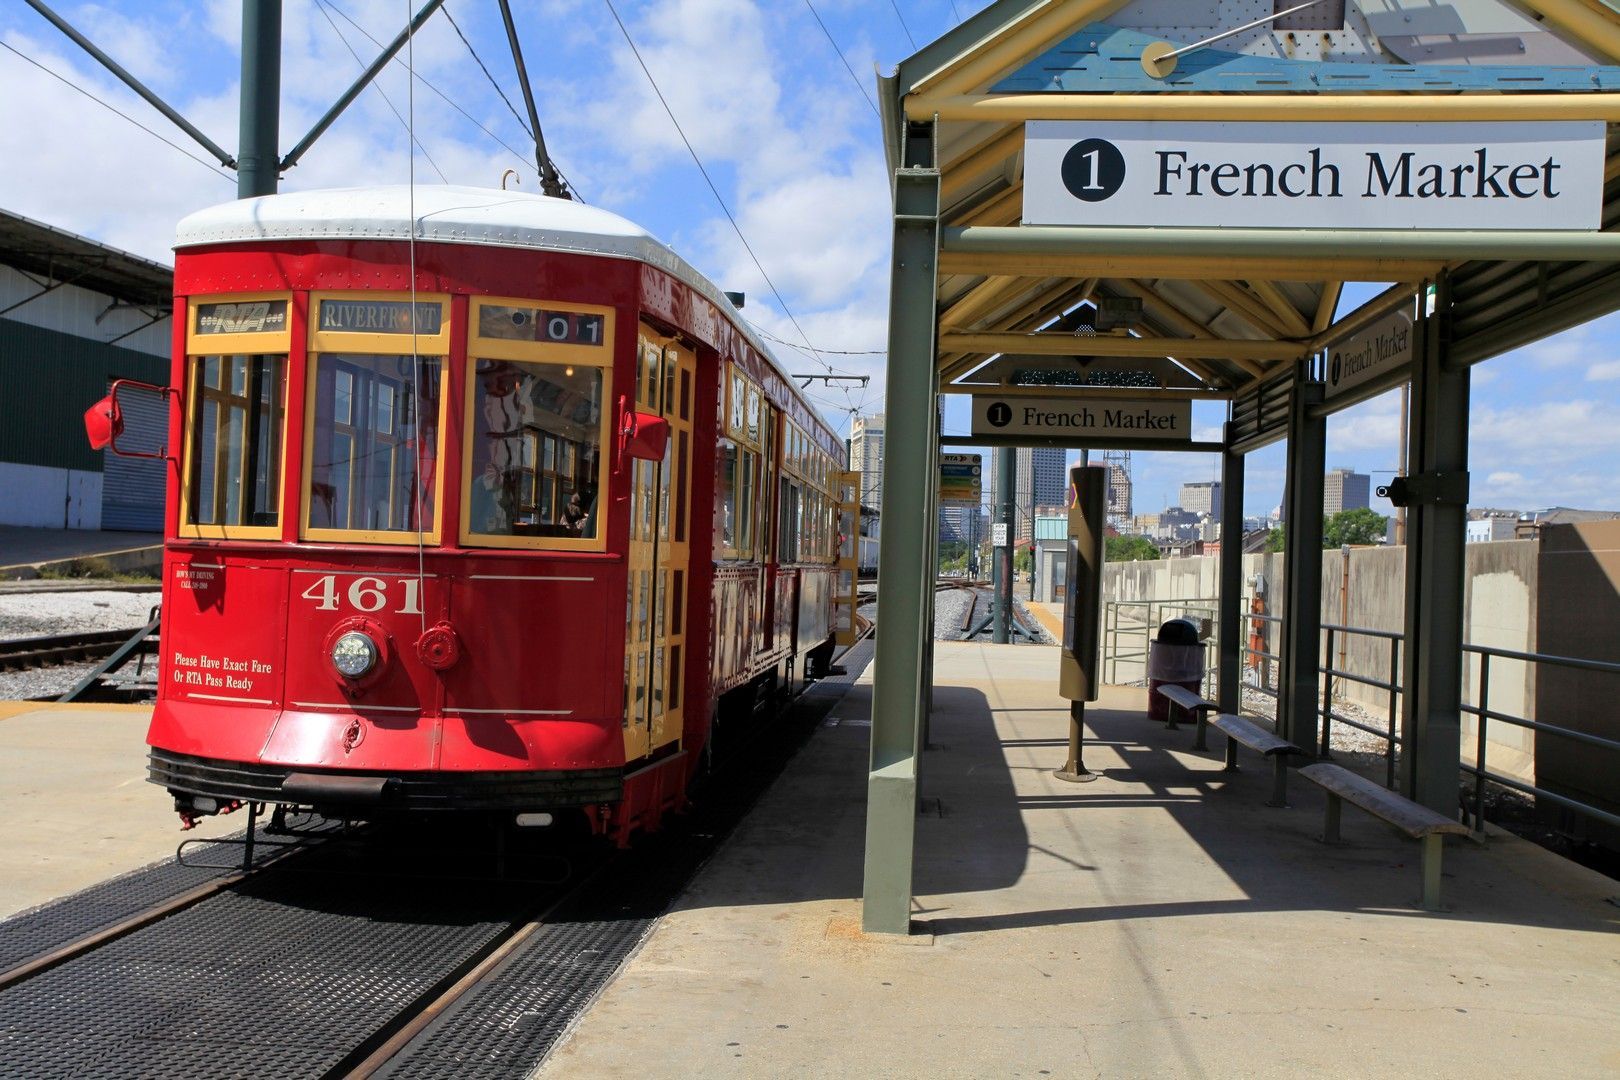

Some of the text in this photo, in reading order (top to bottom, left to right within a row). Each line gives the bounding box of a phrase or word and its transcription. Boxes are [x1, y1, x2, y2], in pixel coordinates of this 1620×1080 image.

[1081, 146, 1561, 199] 1 French Market
[212, 302, 271, 332] RTA
[324, 303, 437, 330] RIVERFRONT
[1343, 340, 1373, 378] French
[1373, 325, 1408, 364] Market
[1023, 407, 1095, 428] French
[1102, 409, 1177, 430] Market
[301, 575, 425, 614] 461
[174, 652, 272, 674] Please Have Exact Fare
[174, 669, 253, 692] Or RTA Pass Ready
